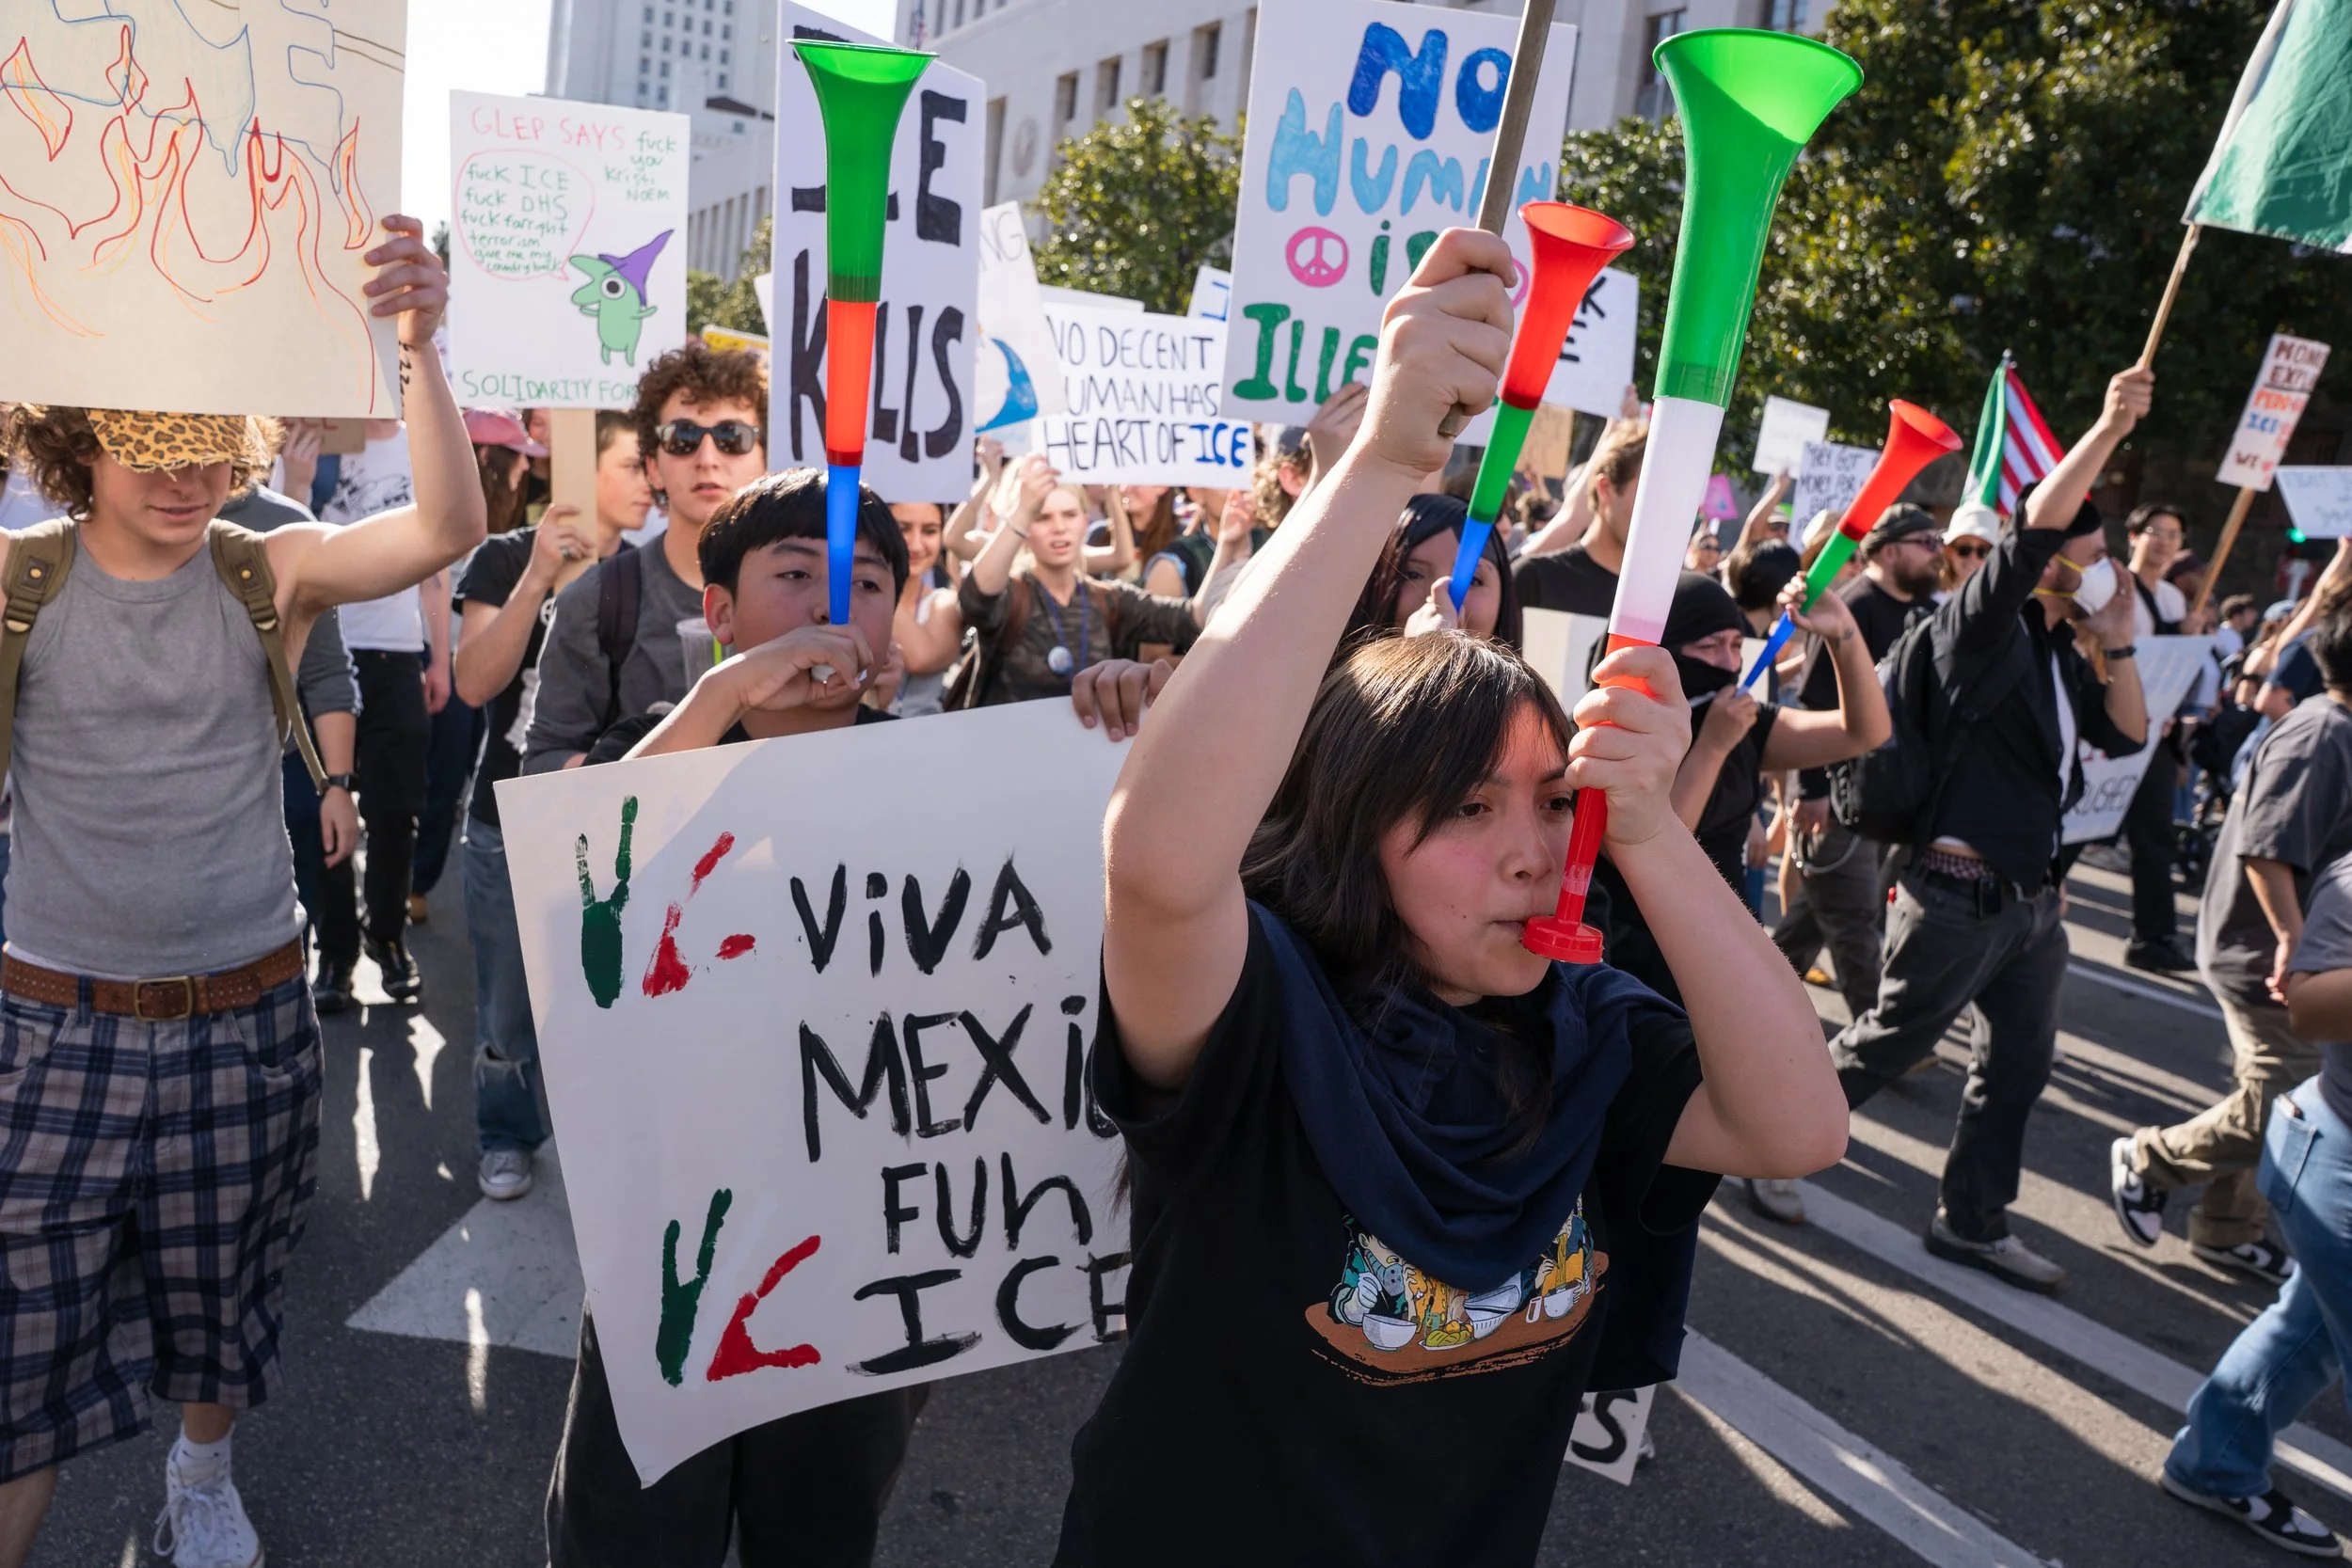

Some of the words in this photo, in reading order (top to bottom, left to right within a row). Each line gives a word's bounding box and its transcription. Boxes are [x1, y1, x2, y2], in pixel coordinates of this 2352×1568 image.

[1347, 22, 1513, 140] NO
[471, 105, 545, 141] GLEP
[559, 117, 626, 151] SAYS
[637, 130, 677, 153] fuck
[518, 165, 570, 191] ICE
[465, 186, 506, 207] fuck
[521, 194, 568, 221] DHS
[469, 230, 540, 246] terrorism
[506, 250, 524, 260] me
[529, 250, 552, 263] my
[791, 248, 965, 463] KLLS
[1098, 325, 1214, 370] DECENT
[462, 369, 592, 403] SOLIDARITY
[1065, 375, 1164, 416] UMAN
[1169, 381, 1219, 417] HAS
[1042, 418, 1151, 470] HEART
[1157, 422, 1185, 464] OF
[1189, 422, 1249, 467] ICE
[845, 1251, 1132, 1377] ICE
